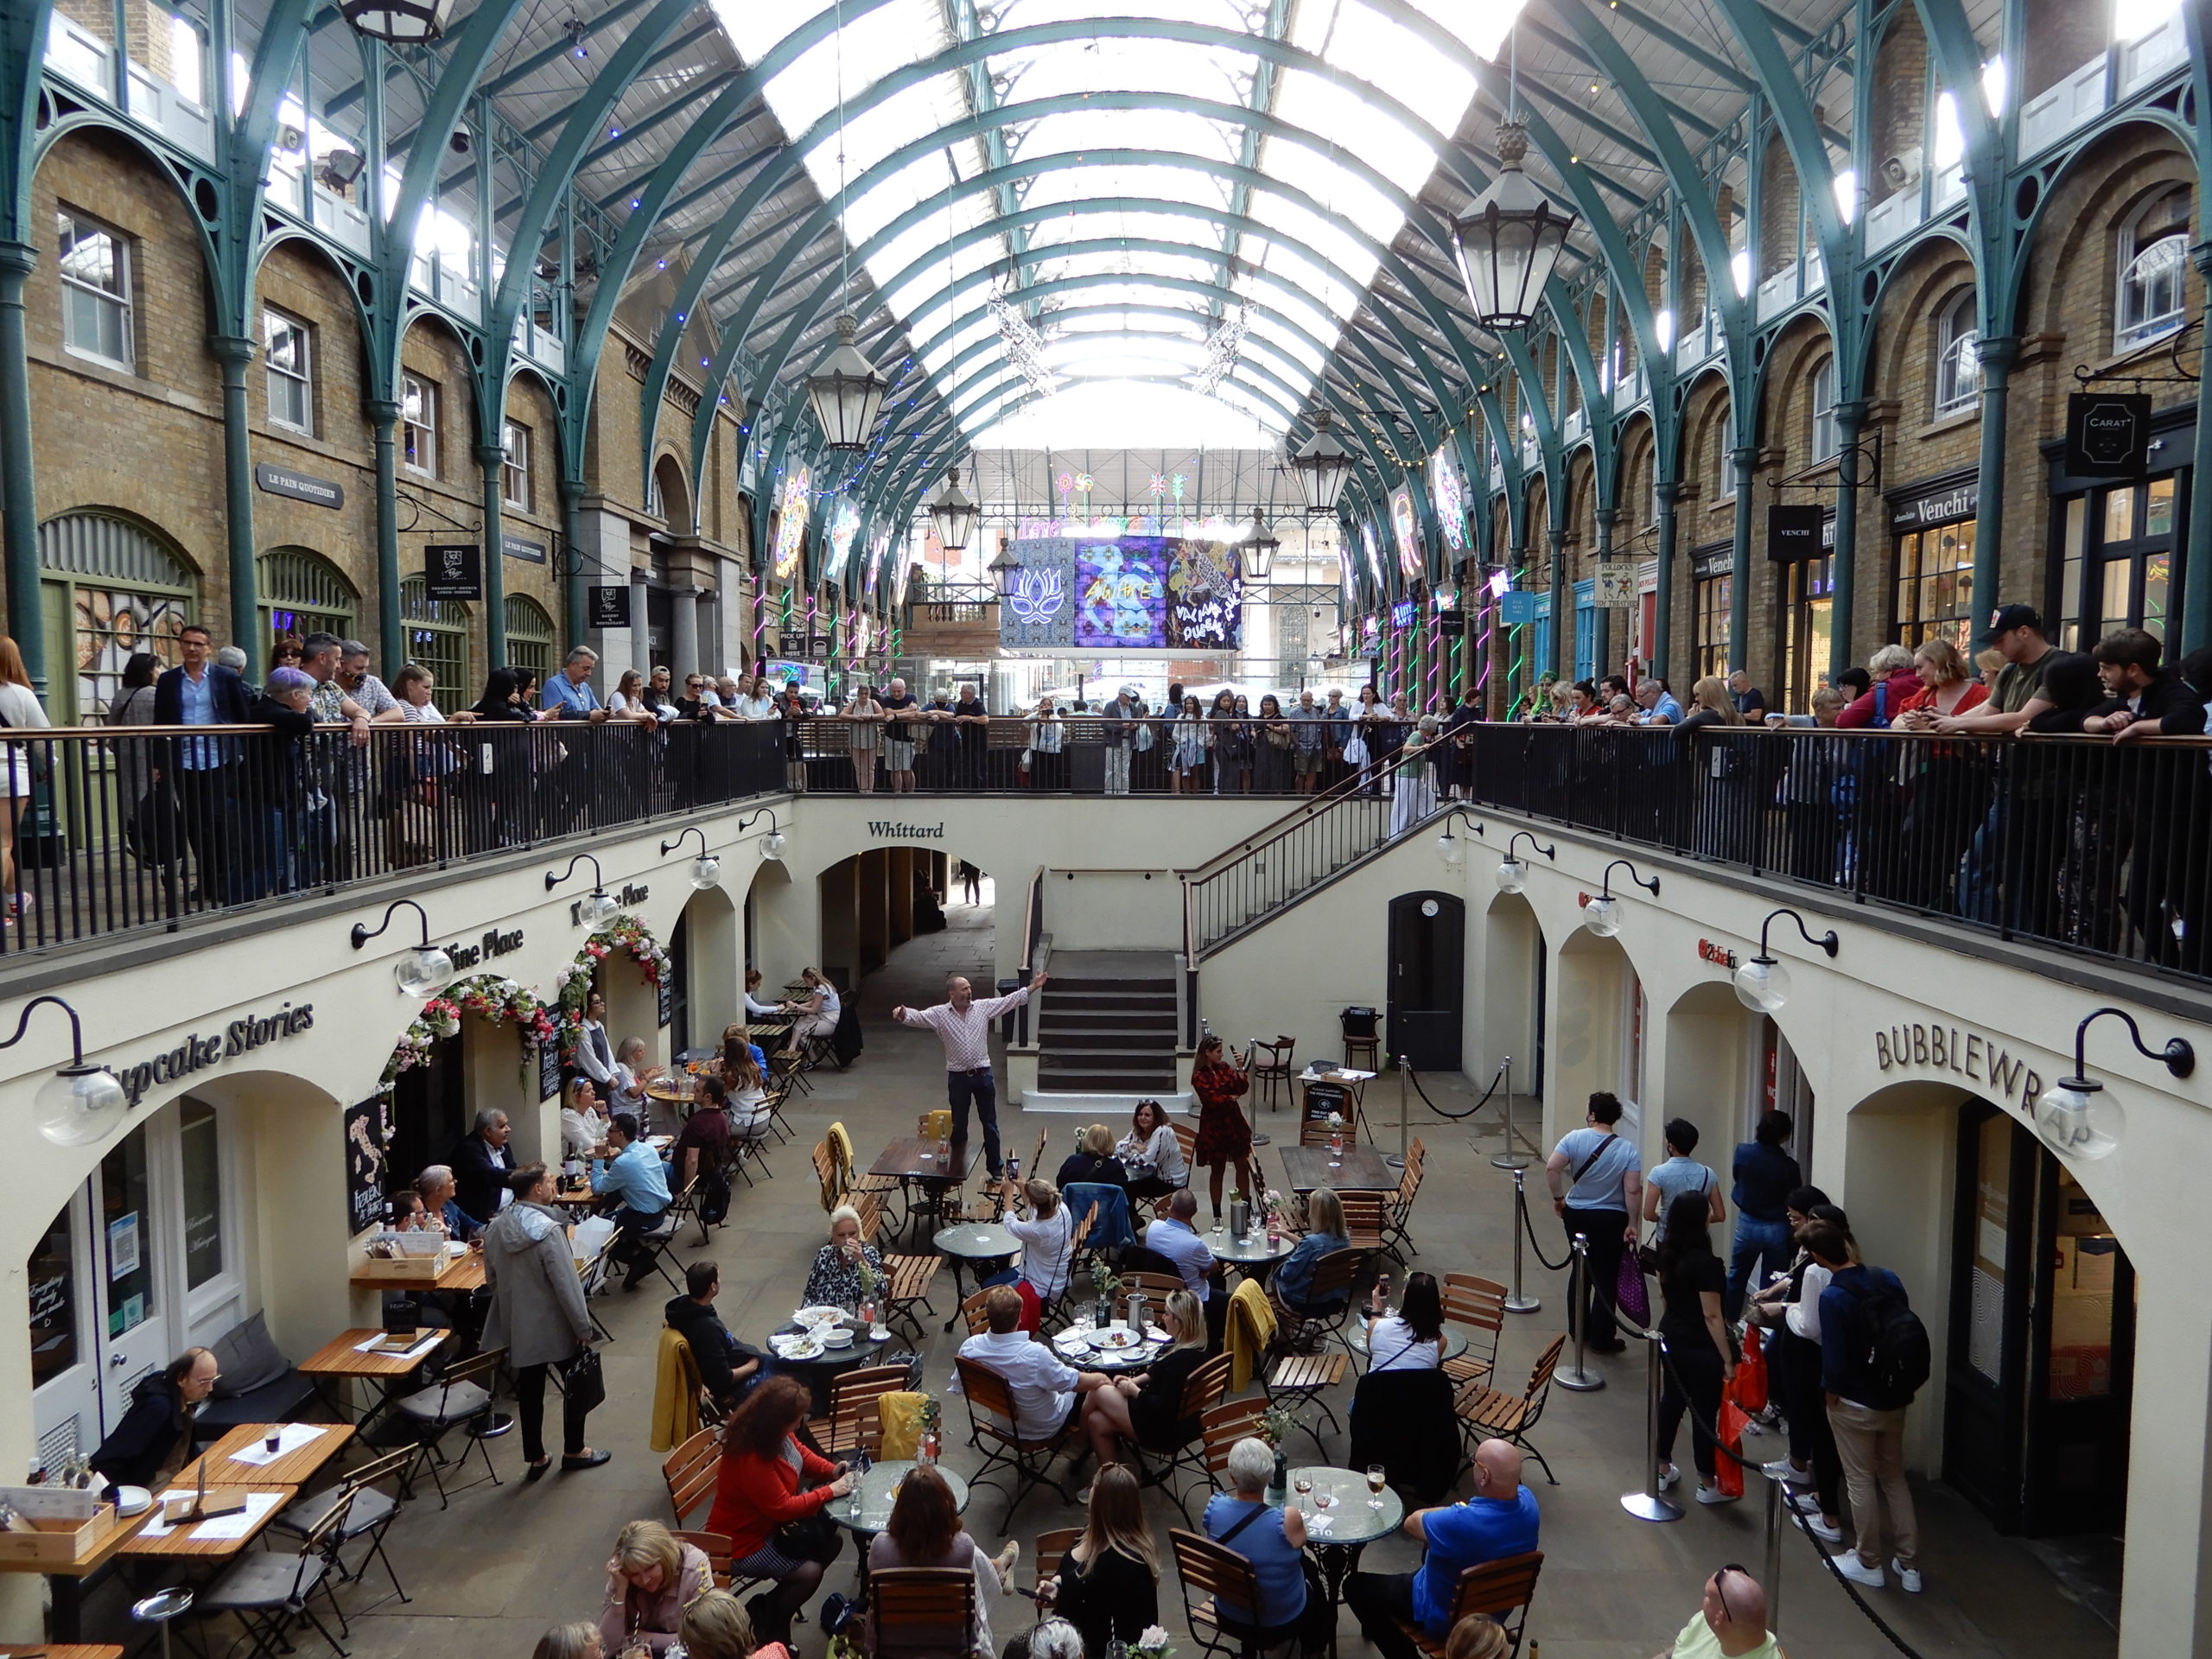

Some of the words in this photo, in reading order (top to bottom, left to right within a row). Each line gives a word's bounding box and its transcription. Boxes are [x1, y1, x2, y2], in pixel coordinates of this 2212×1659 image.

[269, 474, 278, 485] LE
[280, 477, 297, 489] PAIN
[299, 482, 335, 499] QUOTIDIEN
[1917, 489, 1968, 523] Venchi
[1707, 553, 1733, 575] Vench
[868, 821, 944, 837] Whittard
[622, 883, 648, 910] Place
[481, 927, 524, 960] Place
[105, 1033, 222, 1107] upcake
[225, 1001, 314, 1057] Stories
[1308, 1527, 1332, 1536] 210
